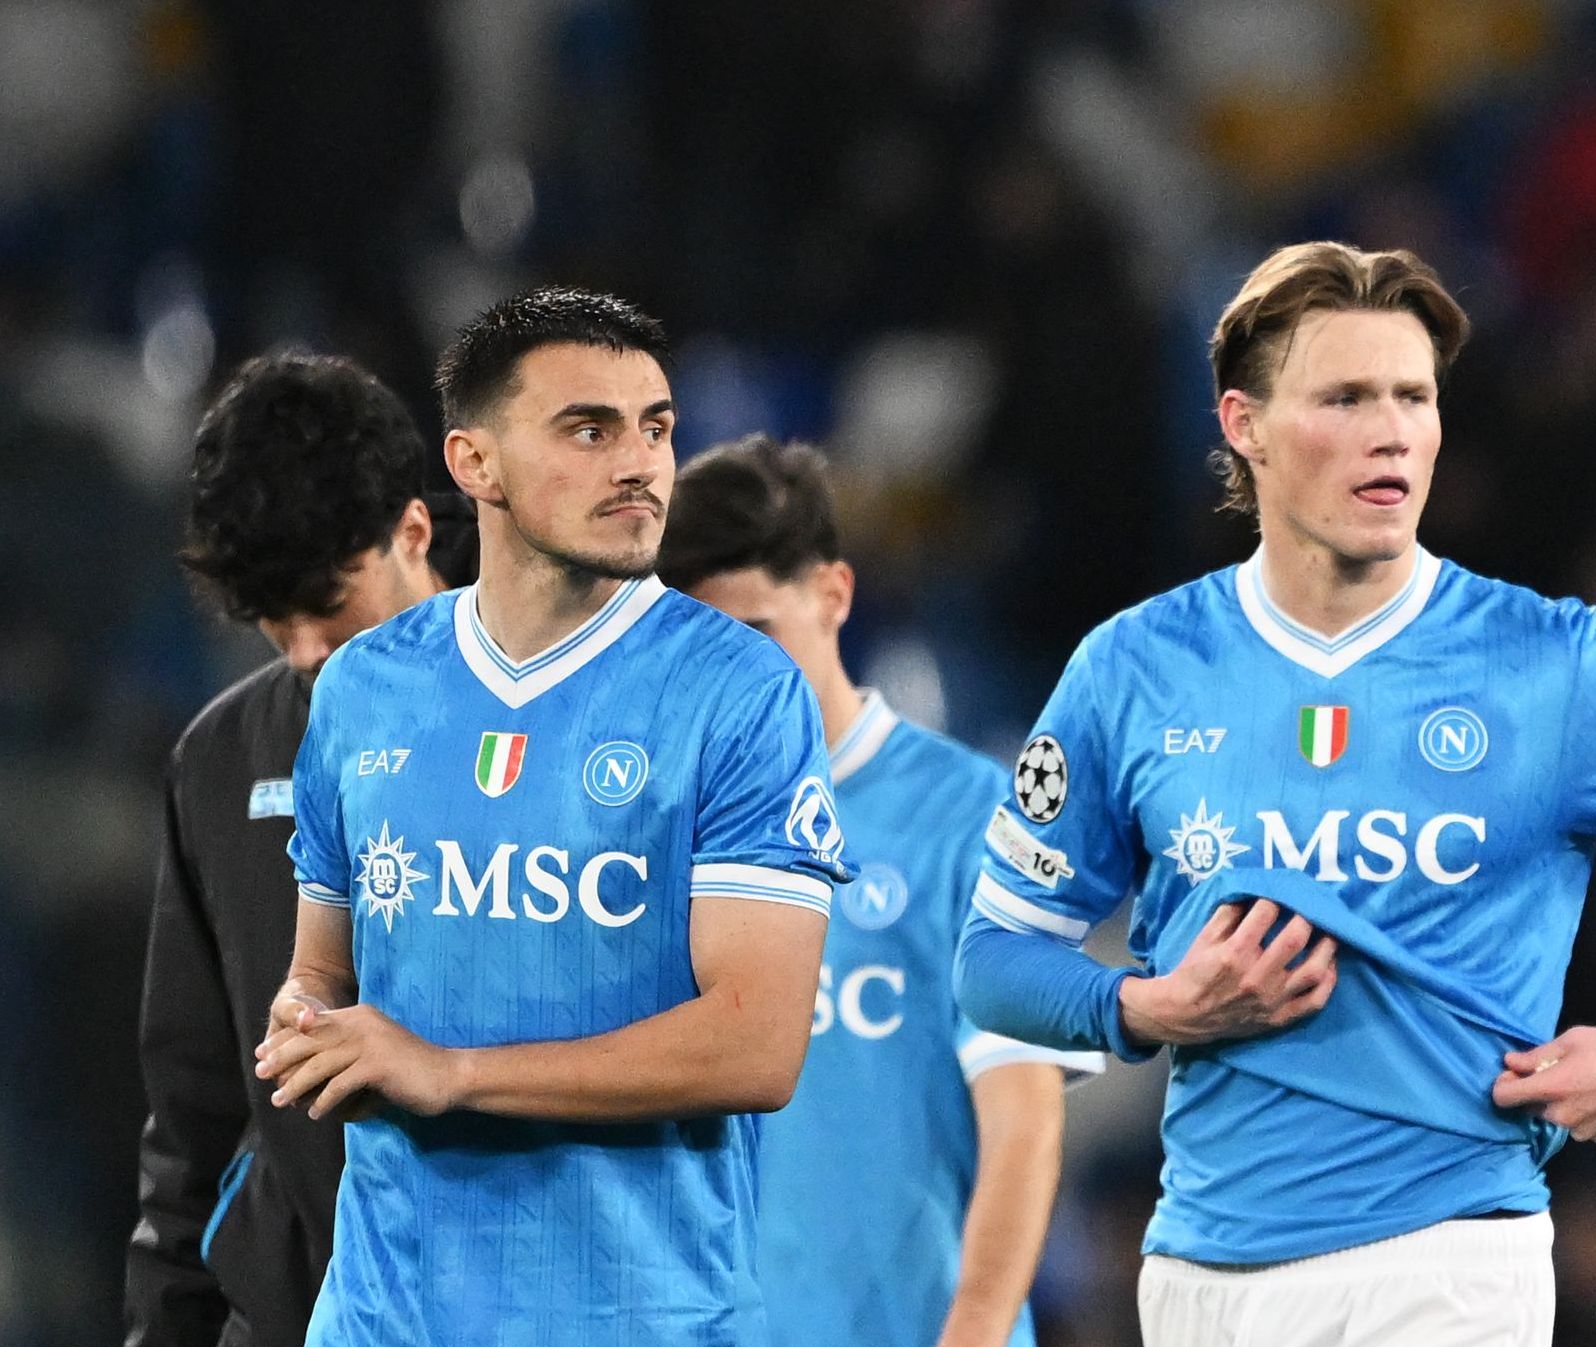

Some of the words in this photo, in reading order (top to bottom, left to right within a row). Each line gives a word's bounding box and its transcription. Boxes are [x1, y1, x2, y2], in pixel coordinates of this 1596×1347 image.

[1164, 728, 1227, 754] EA7
[1439, 729, 1467, 753] N
[357, 748, 411, 776] EA7
[602, 759, 633, 787] N
[1257, 809, 1486, 884] MSC
[1033, 852, 1057, 877] 10
[432, 840, 648, 927] MSC
